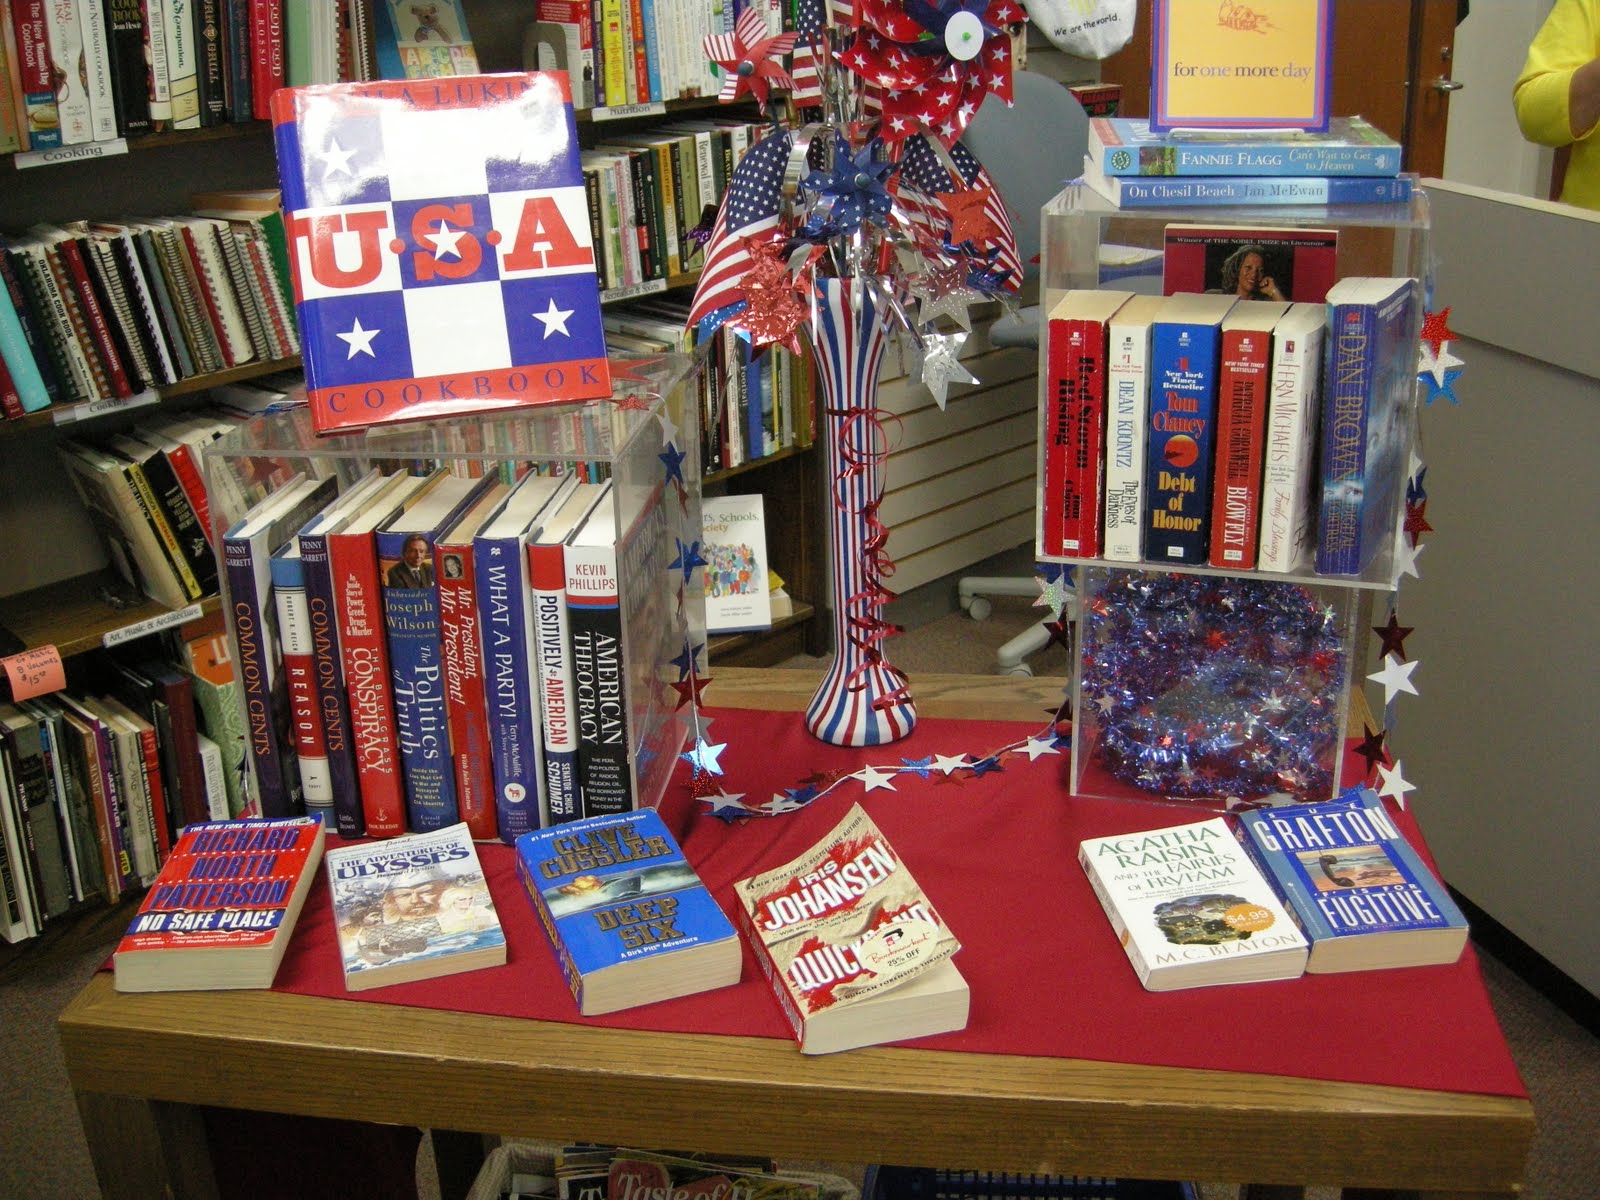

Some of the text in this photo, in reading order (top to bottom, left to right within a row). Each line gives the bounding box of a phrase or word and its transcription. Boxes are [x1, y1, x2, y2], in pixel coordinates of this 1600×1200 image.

[30, 2, 41, 18] The
[112, 10, 142, 21] BOOK
[33, 20, 44, 40] New
[1054, 19, 1095, 36] We are the
[22, 23, 36, 68] Cookbook
[36, 42, 49, 72] Woman's
[151, 11, 166, 81] MORE TASTE THAN TIME
[257, 20, 267, 66] ROSSO
[270, 40, 282, 77] FOOD
[1173, 62, 1312, 80] for one more day
[39, 72, 50, 86] Day
[96, 54, 106, 98] COOKBOOK
[610, 105, 651, 116] Nutrition
[43, 146, 103, 162] Cooking
[698, 140, 708, 180] Renewal
[1181, 152, 1282, 165] FANNIE FLAGG
[1316, 150, 1338, 161] Wait
[1318, 160, 1355, 172] Heaven
[1129, 184, 1323, 198] On Chesil Beach Ian McEwan
[38, 259, 74, 339] OKLAHOMA COOK BOOK
[99, 329, 120, 372] COOKBOOK
[328, 364, 600, 413] COOKBOOK
[1119, 380, 1135, 416] DEAN
[1163, 382, 1204, 391] Bestseller
[1166, 391, 1198, 412] Tom
[1332, 334, 1367, 482] DAN BROWN
[1076, 406, 1095, 469] Storm
[1153, 411, 1206, 439] Clancy
[1116, 419, 1134, 468] KOONTZ
[1158, 471, 1196, 490] Debt
[1168, 494, 1184, 511] of
[1152, 512, 1202, 531] Honor
[226, 546, 246, 555] PENNY
[301, 541, 322, 550] PENNY
[301, 553, 328, 562] GARRETT
[225, 558, 251, 566] GARRETT
[575, 564, 607, 576] KEVIN
[346, 581, 361, 589] Inside
[569, 578, 615, 590] PHILLIPS
[346, 597, 366, 607] Power,
[347, 607, 367, 617] Greed,
[385, 598, 434, 618] Joseph
[124, 607, 200, 637] Music Architecture
[349, 617, 367, 628] Drugs
[352, 627, 373, 636] Murder
[386, 614, 436, 631] Wilson
[539, 596, 562, 669] POSITIVELY
[488, 565, 517, 719] WHAT A PARTY!
[310, 597, 344, 752] COMMON CENTS
[443, 618, 465, 705] President!
[236, 601, 270, 756] COMMON CENTS
[574, 632, 599, 745] THEOCRACY
[595, 631, 623, 745] AMERICAN
[292, 668, 315, 744] REASON
[352, 648, 385, 773] CONSPIRACY
[371, 647, 393, 774] THE BLUEGRASS
[395, 682, 421, 754] Truth
[415, 664, 444, 760] Politics
[545, 677, 568, 746] AMERICAN
[546, 760, 563, 816] SCHUMER
[561, 762, 571, 791] SENATOR
[107, 771, 121, 828] JAZZ STYLES
[552, 823, 642, 855] CLIVE
[555, 828, 570, 836] York
[590, 818, 625, 828] Bestselling
[626, 814, 647, 822] Author
[1253, 806, 1399, 852] GRAFTON
[190, 828, 300, 853] RICHARD
[1098, 827, 1220, 857] AGATHA
[120, 853, 130, 874] USED
[188, 854, 278, 880] NORTH
[337, 847, 470, 880] ULYSSES
[341, 842, 460, 868] THE ADVENTURES OF
[538, 836, 675, 880] CUSSLER
[1113, 872, 1138, 881] AND
[1166, 853, 1236, 873] FAIRIES
[1116, 842, 1215, 868] RAISIN
[764, 841, 897, 931] JOHANSEN
[799, 860, 839, 887] IRIS
[1128, 882, 1142, 891] OF
[1146, 867, 1235, 889] FRYFAM
[148, 880, 290, 910] PATTERSON
[1351, 884, 1418, 895] IS FOR
[136, 909, 277, 933] NO SAFE PLACE
[593, 897, 681, 931] DEEP
[1226, 910, 1268, 923] $4.99
[1318, 890, 1440, 929] FUGITIVE
[618, 918, 687, 950] SIX
[627, 936, 698, 957] Dirk Adventure
[906, 948, 920, 958] OFF
[1155, 933, 1298, 965] M.C. BEATON
